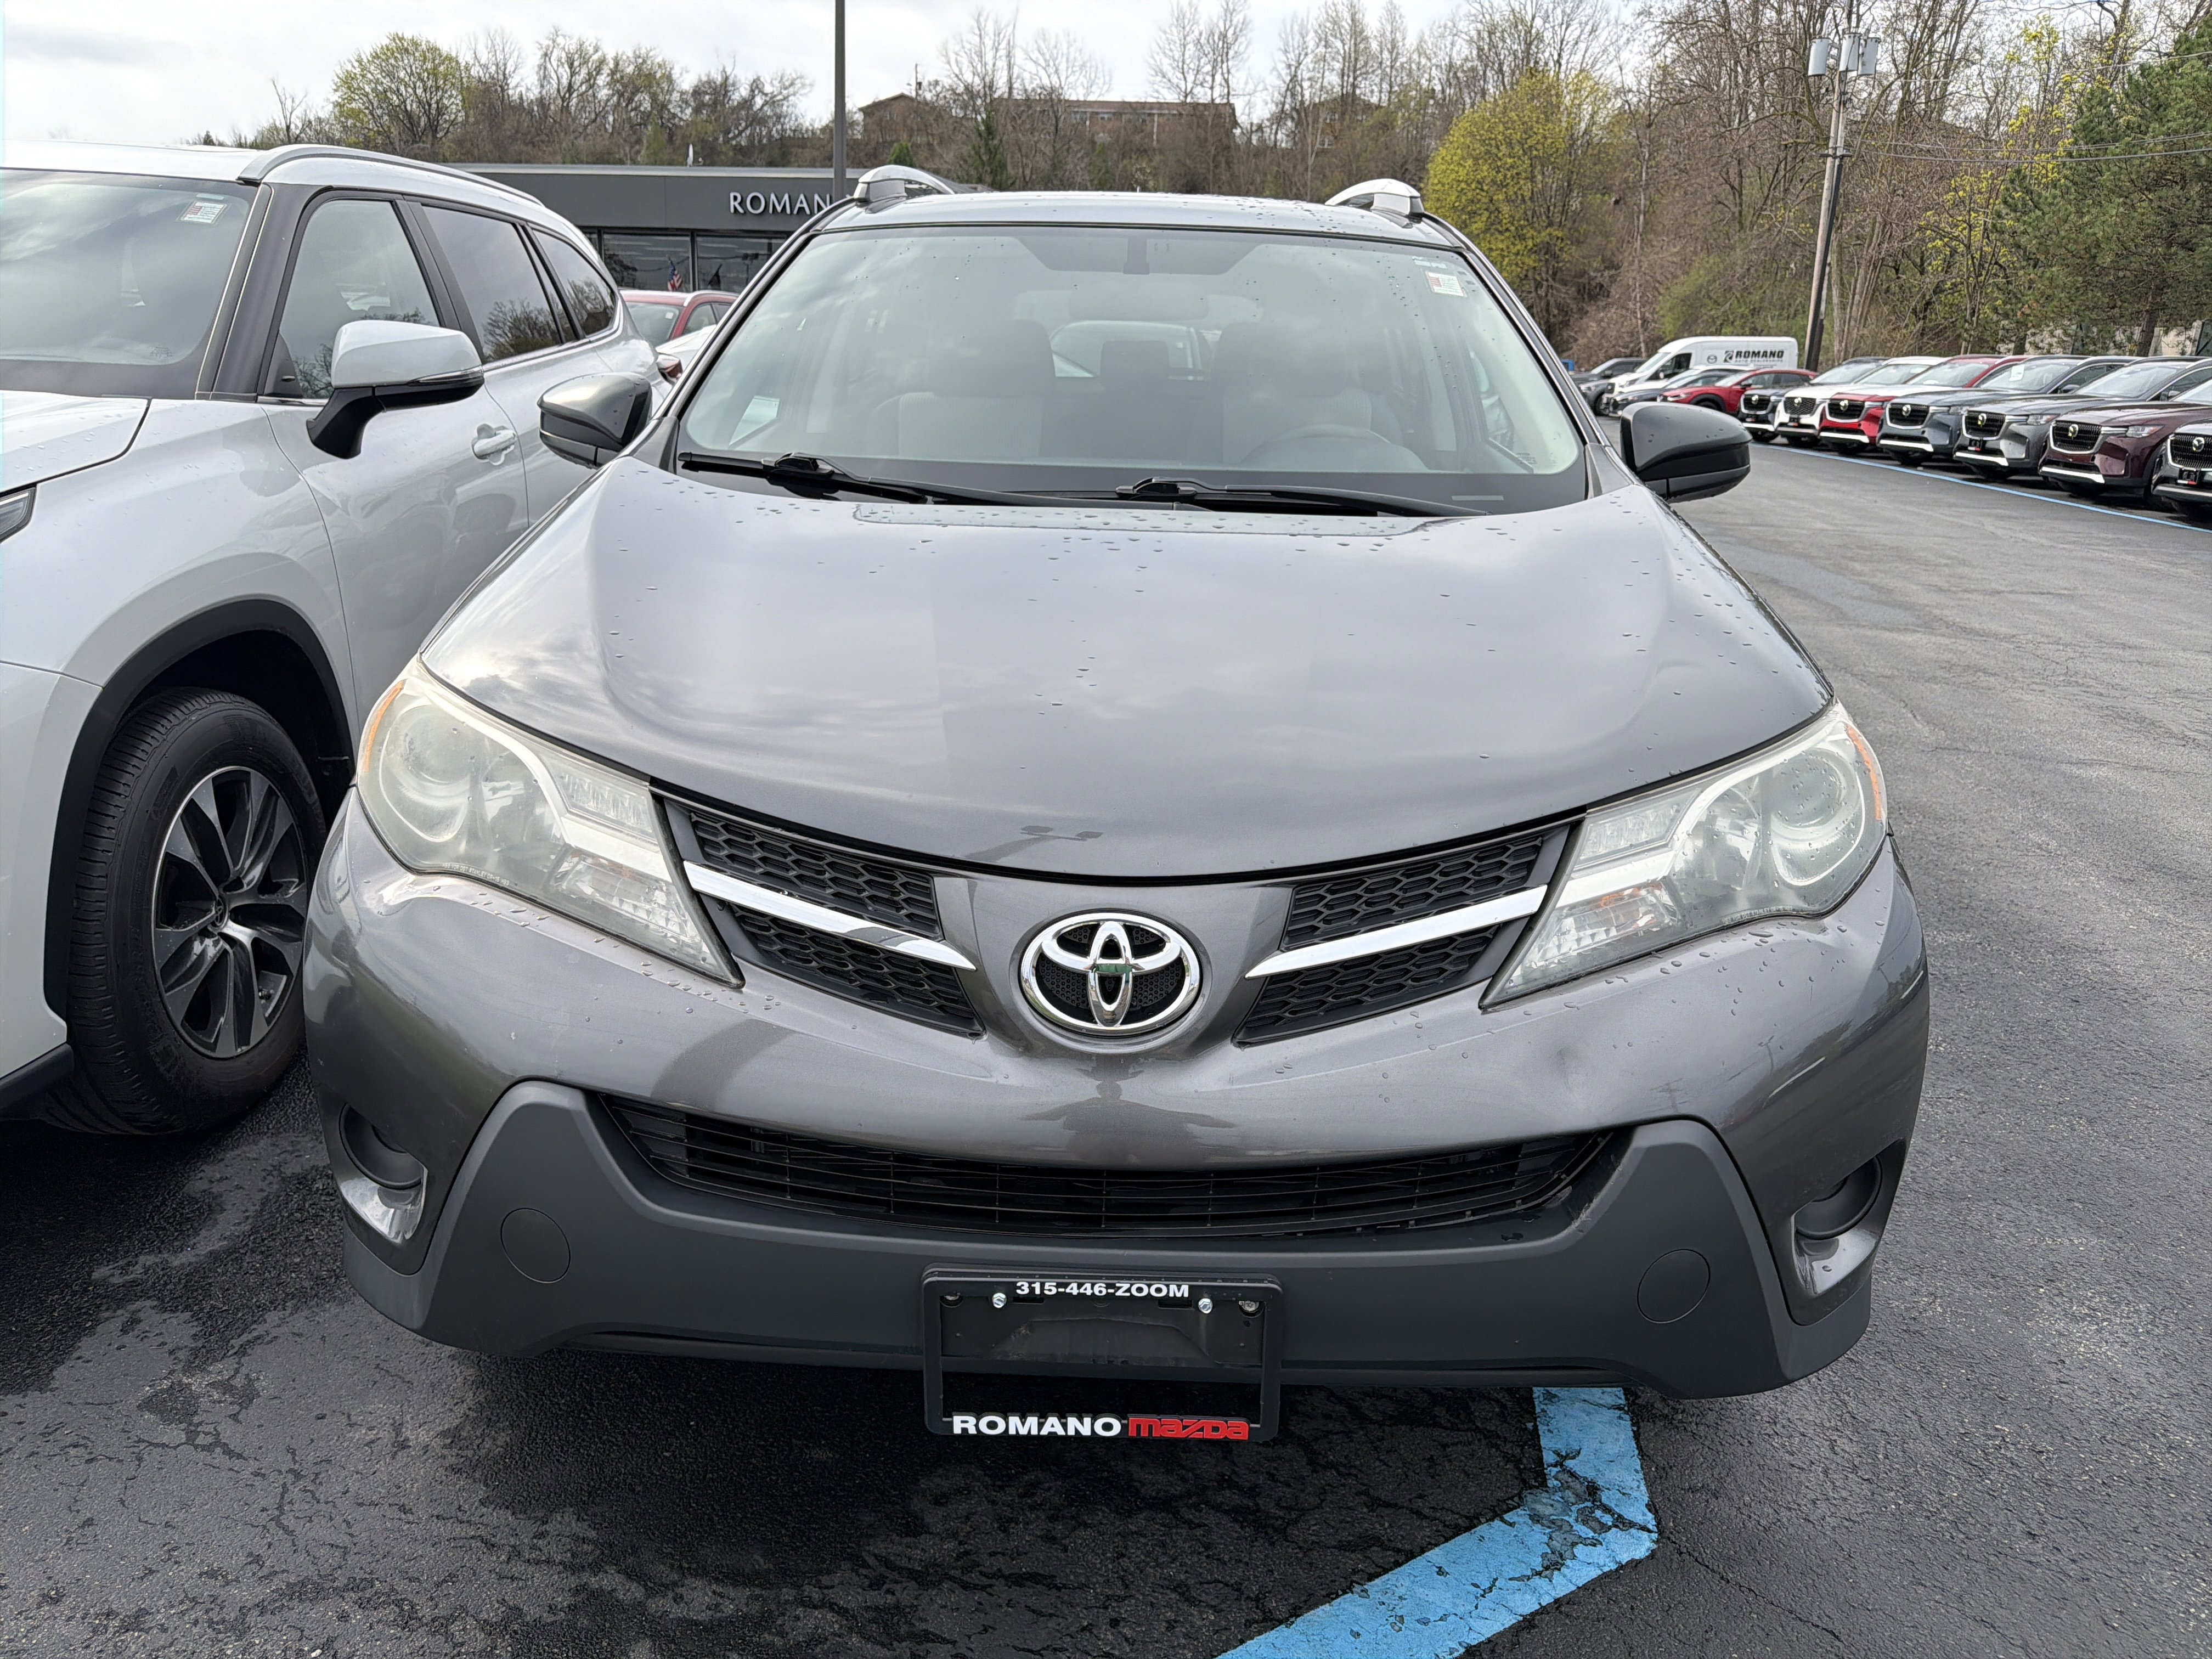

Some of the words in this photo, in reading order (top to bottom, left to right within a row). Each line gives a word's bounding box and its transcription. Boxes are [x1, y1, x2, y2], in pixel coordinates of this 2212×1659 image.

[729, 191, 851, 215] ROMAN
[1735, 350, 1785, 359] ROMANO
[469, 867, 487, 878] STANLEY
[1015, 1281, 1189, 1298] 315-446-ZOOM
[952, 1414, 1122, 1437] ROMANO
